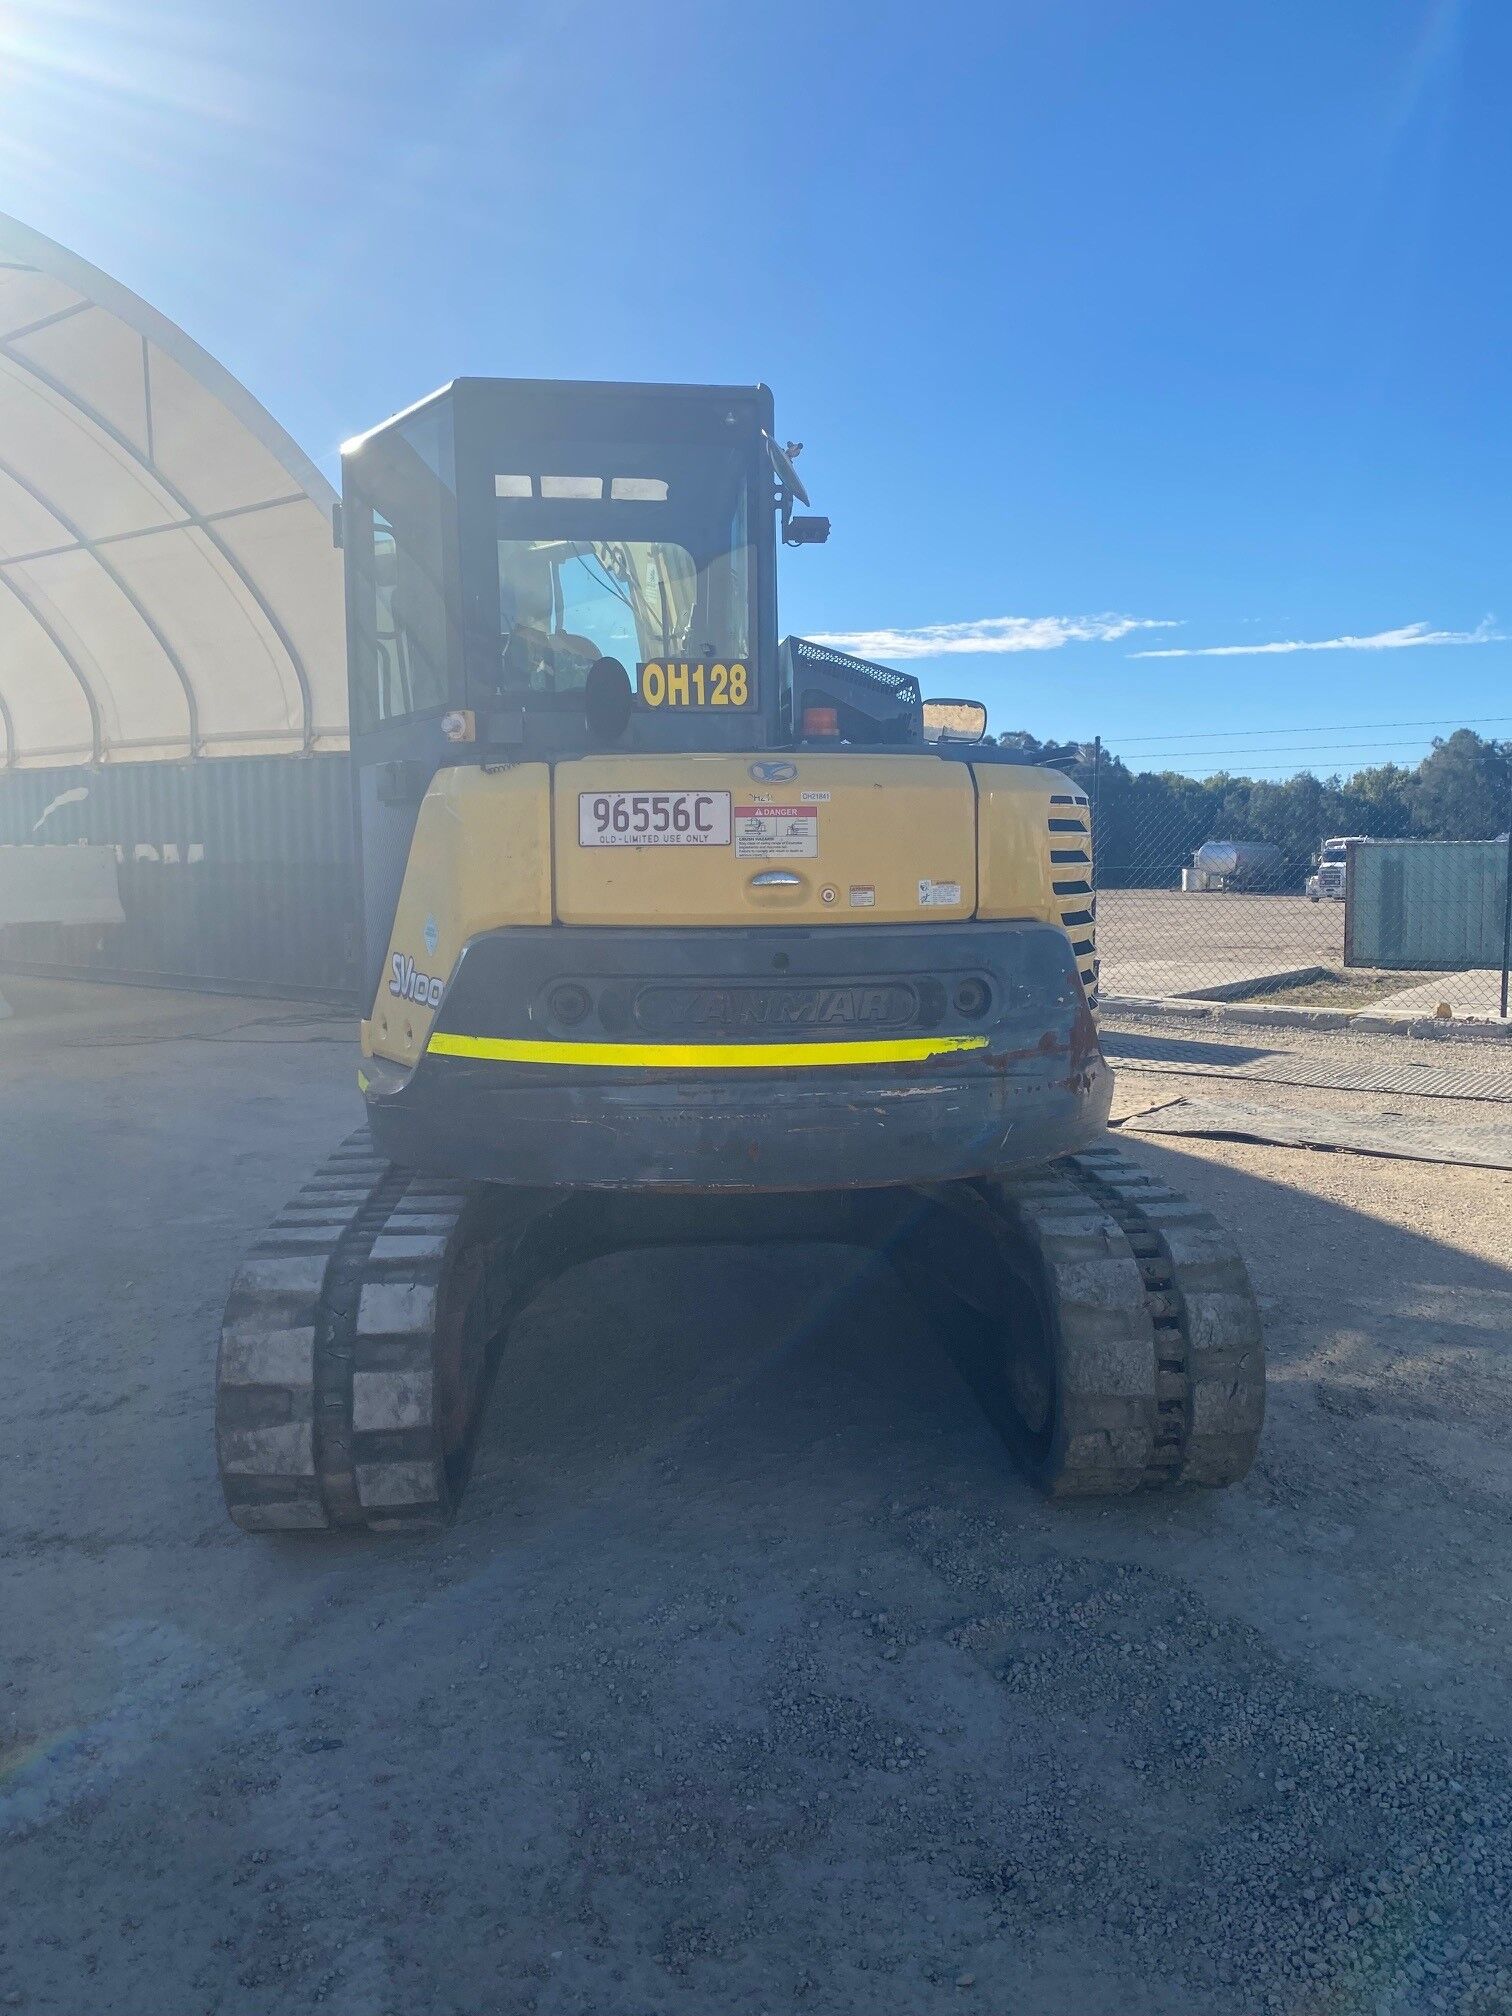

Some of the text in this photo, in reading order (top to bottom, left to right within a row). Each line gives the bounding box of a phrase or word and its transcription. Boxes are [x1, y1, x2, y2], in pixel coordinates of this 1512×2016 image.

[642, 663, 748, 706] OH128
[593, 797, 713, 832] 96556C
[624, 834, 659, 843] LIMITED
[663, 834, 681, 843] USE
[686, 834, 709, 843] ONLY
[388, 951, 445, 1008] SV100
